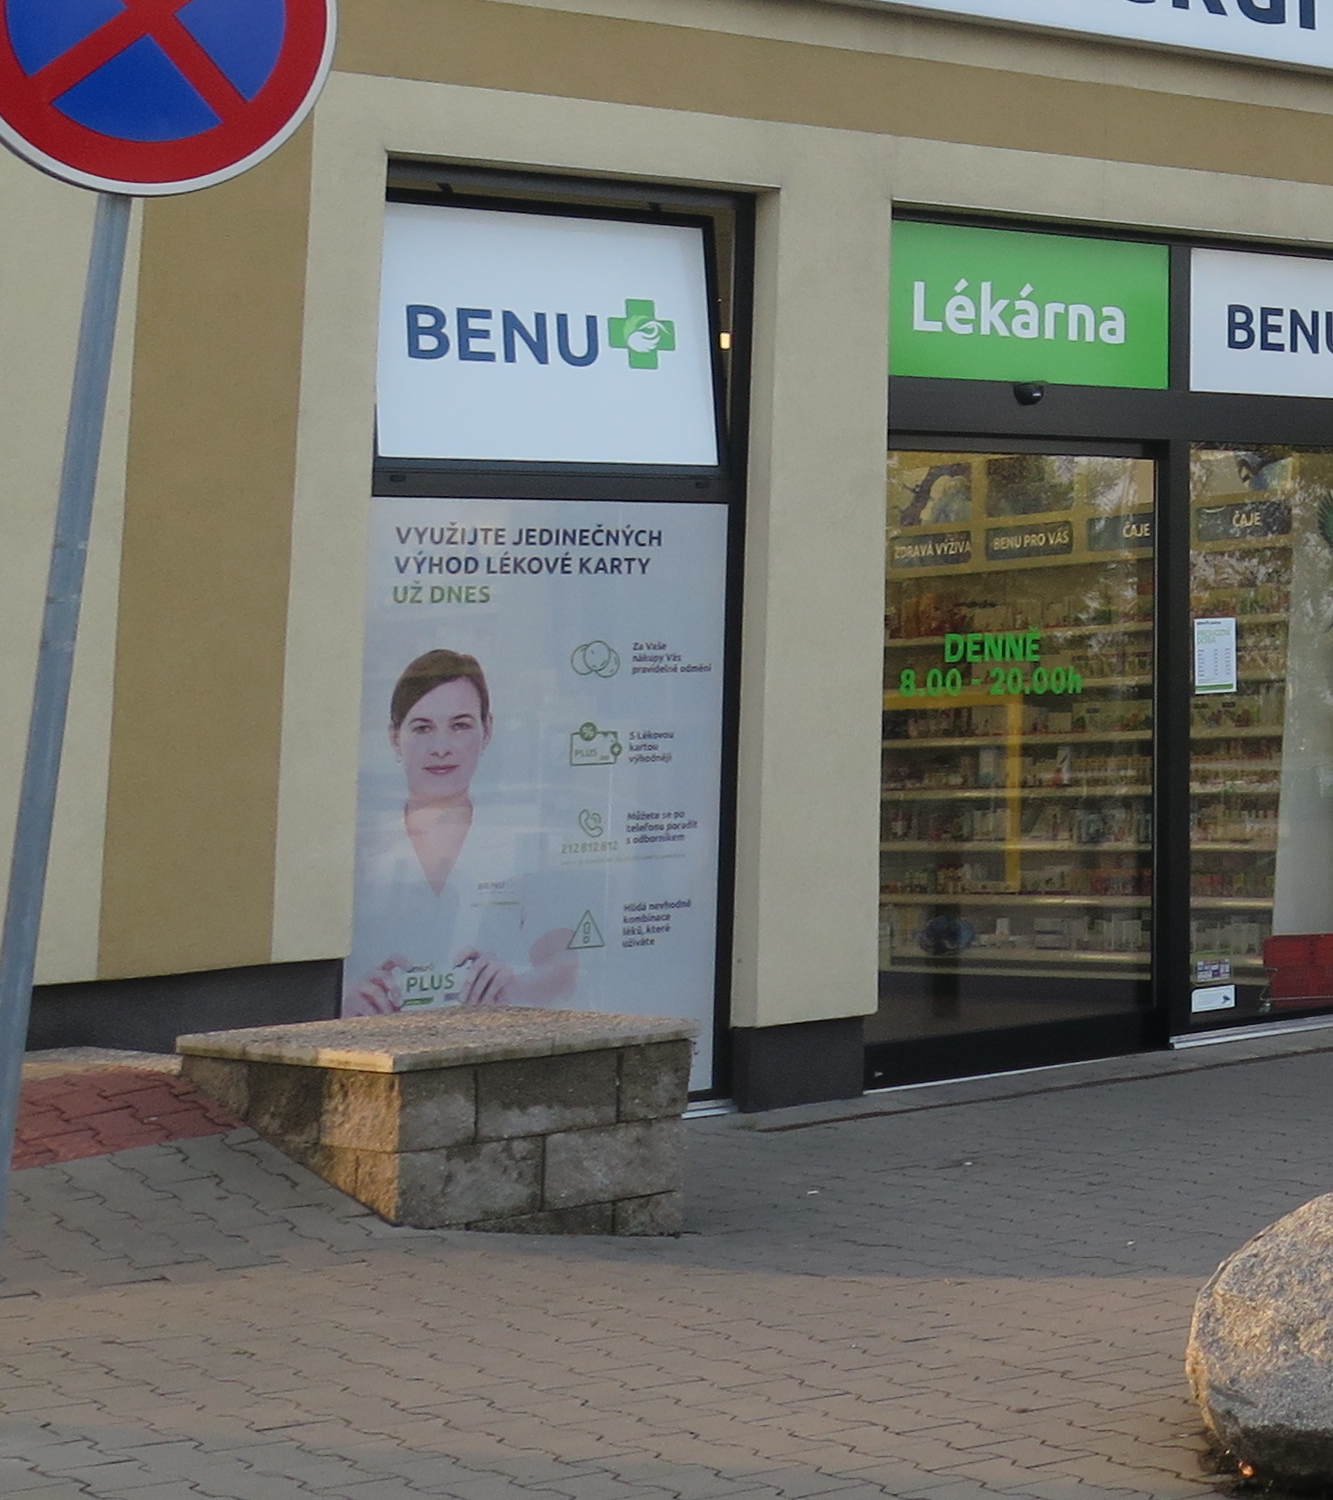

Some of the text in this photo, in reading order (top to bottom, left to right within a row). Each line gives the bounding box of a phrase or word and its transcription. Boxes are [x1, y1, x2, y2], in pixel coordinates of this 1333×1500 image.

[912, 278, 1127, 346] Lékárna
[406, 305, 600, 368] BENU
[1123, 521, 1151, 539] ČAJE
[1232, 511, 1262, 529] ČAJE
[395, 522, 663, 548] VYUŽIJTE JEDINEČNÝCH
[993, 525, 1070, 551] BENU PRO VÁS
[893, 535, 971, 562] ZDRAVÁ VÝŽIVA
[395, 550, 650, 576] VÝHOD LÉKOVÉ KARTY
[392, 580, 491, 604] UŽ DNES
[632, 642, 644, 651] Za
[944, 626, 1041, 665] DENNĚ
[632, 653, 664, 663] nákupy
[898, 667, 963, 699] 8.00
[988, 665, 1083, 697] 20.00h
[629, 742, 659, 752] kartou
[623, 913, 672, 924] kombinace
[646, 924, 672, 934] které
[406, 972, 455, 993] PLUS
